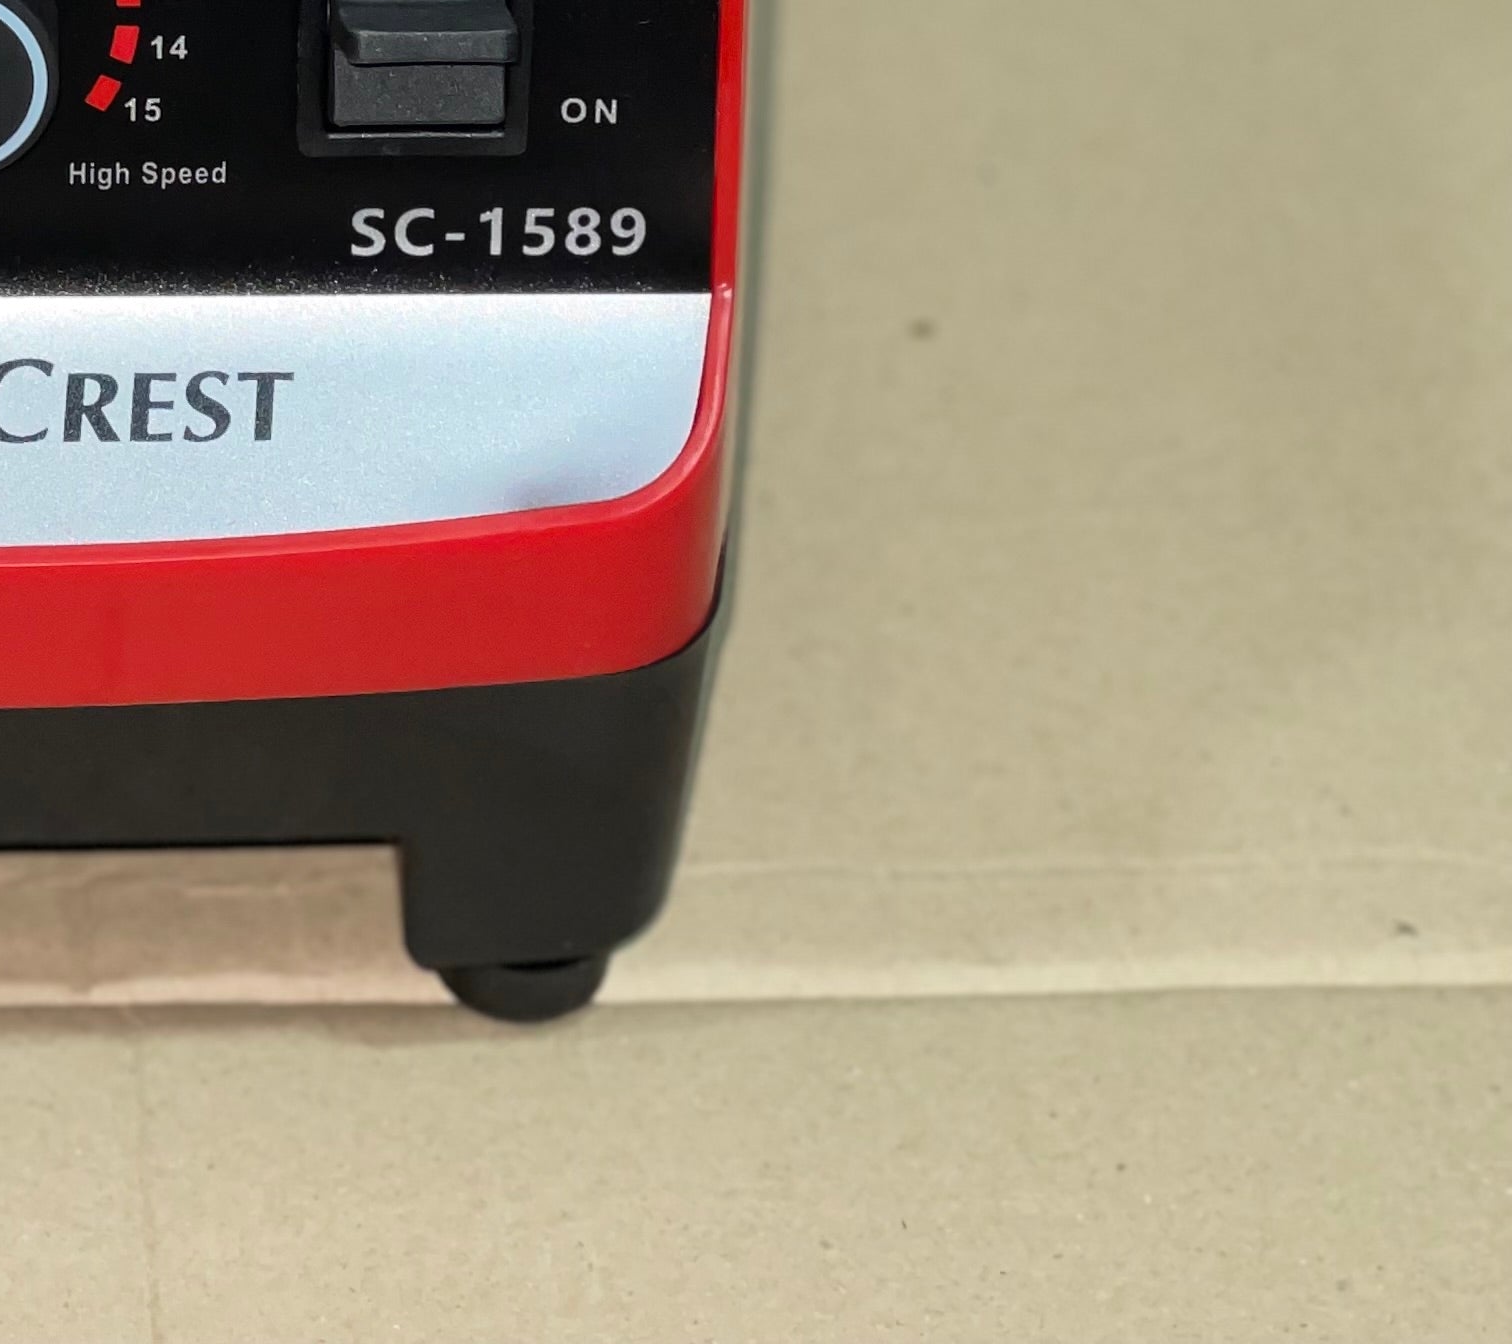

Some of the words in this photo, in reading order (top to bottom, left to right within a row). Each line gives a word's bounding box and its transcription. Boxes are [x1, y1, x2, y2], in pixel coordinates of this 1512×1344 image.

[150, 35, 189, 60] 14
[124, 97, 161, 122] 15
[559, 96, 619, 125] ON
[69, 161, 130, 191] High
[141, 160, 227, 190] Speed
[349, 205, 648, 258] SC-1589
